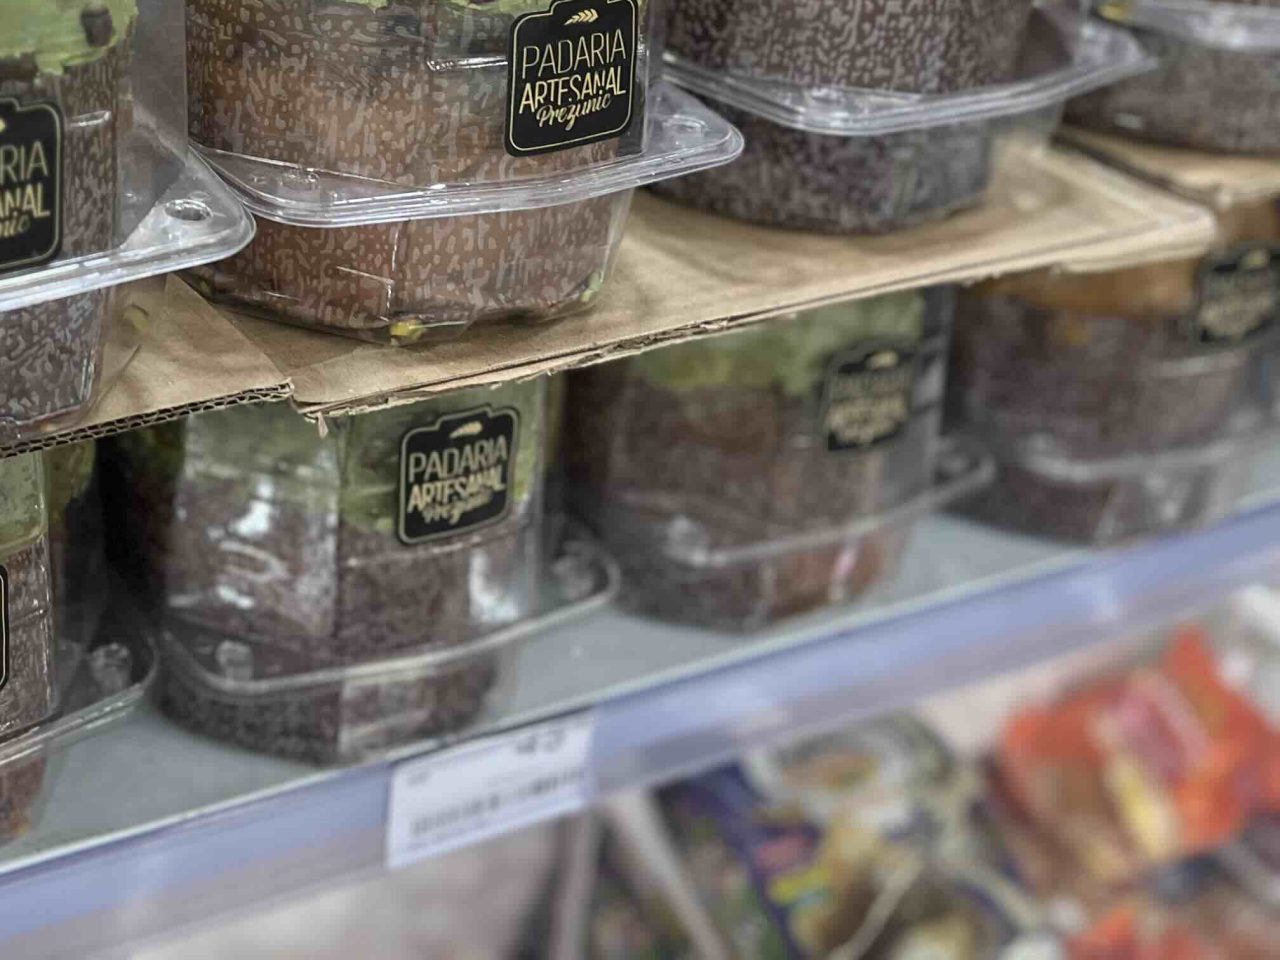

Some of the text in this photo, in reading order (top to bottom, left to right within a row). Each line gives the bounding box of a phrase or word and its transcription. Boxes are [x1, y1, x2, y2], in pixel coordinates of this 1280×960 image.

[522, 29, 626, 79] PADARIA
[519, 66, 626, 114] ARTESANAL
[536, 90, 611, 131] Prezunic
[408, 435, 507, 483] PADARIA
